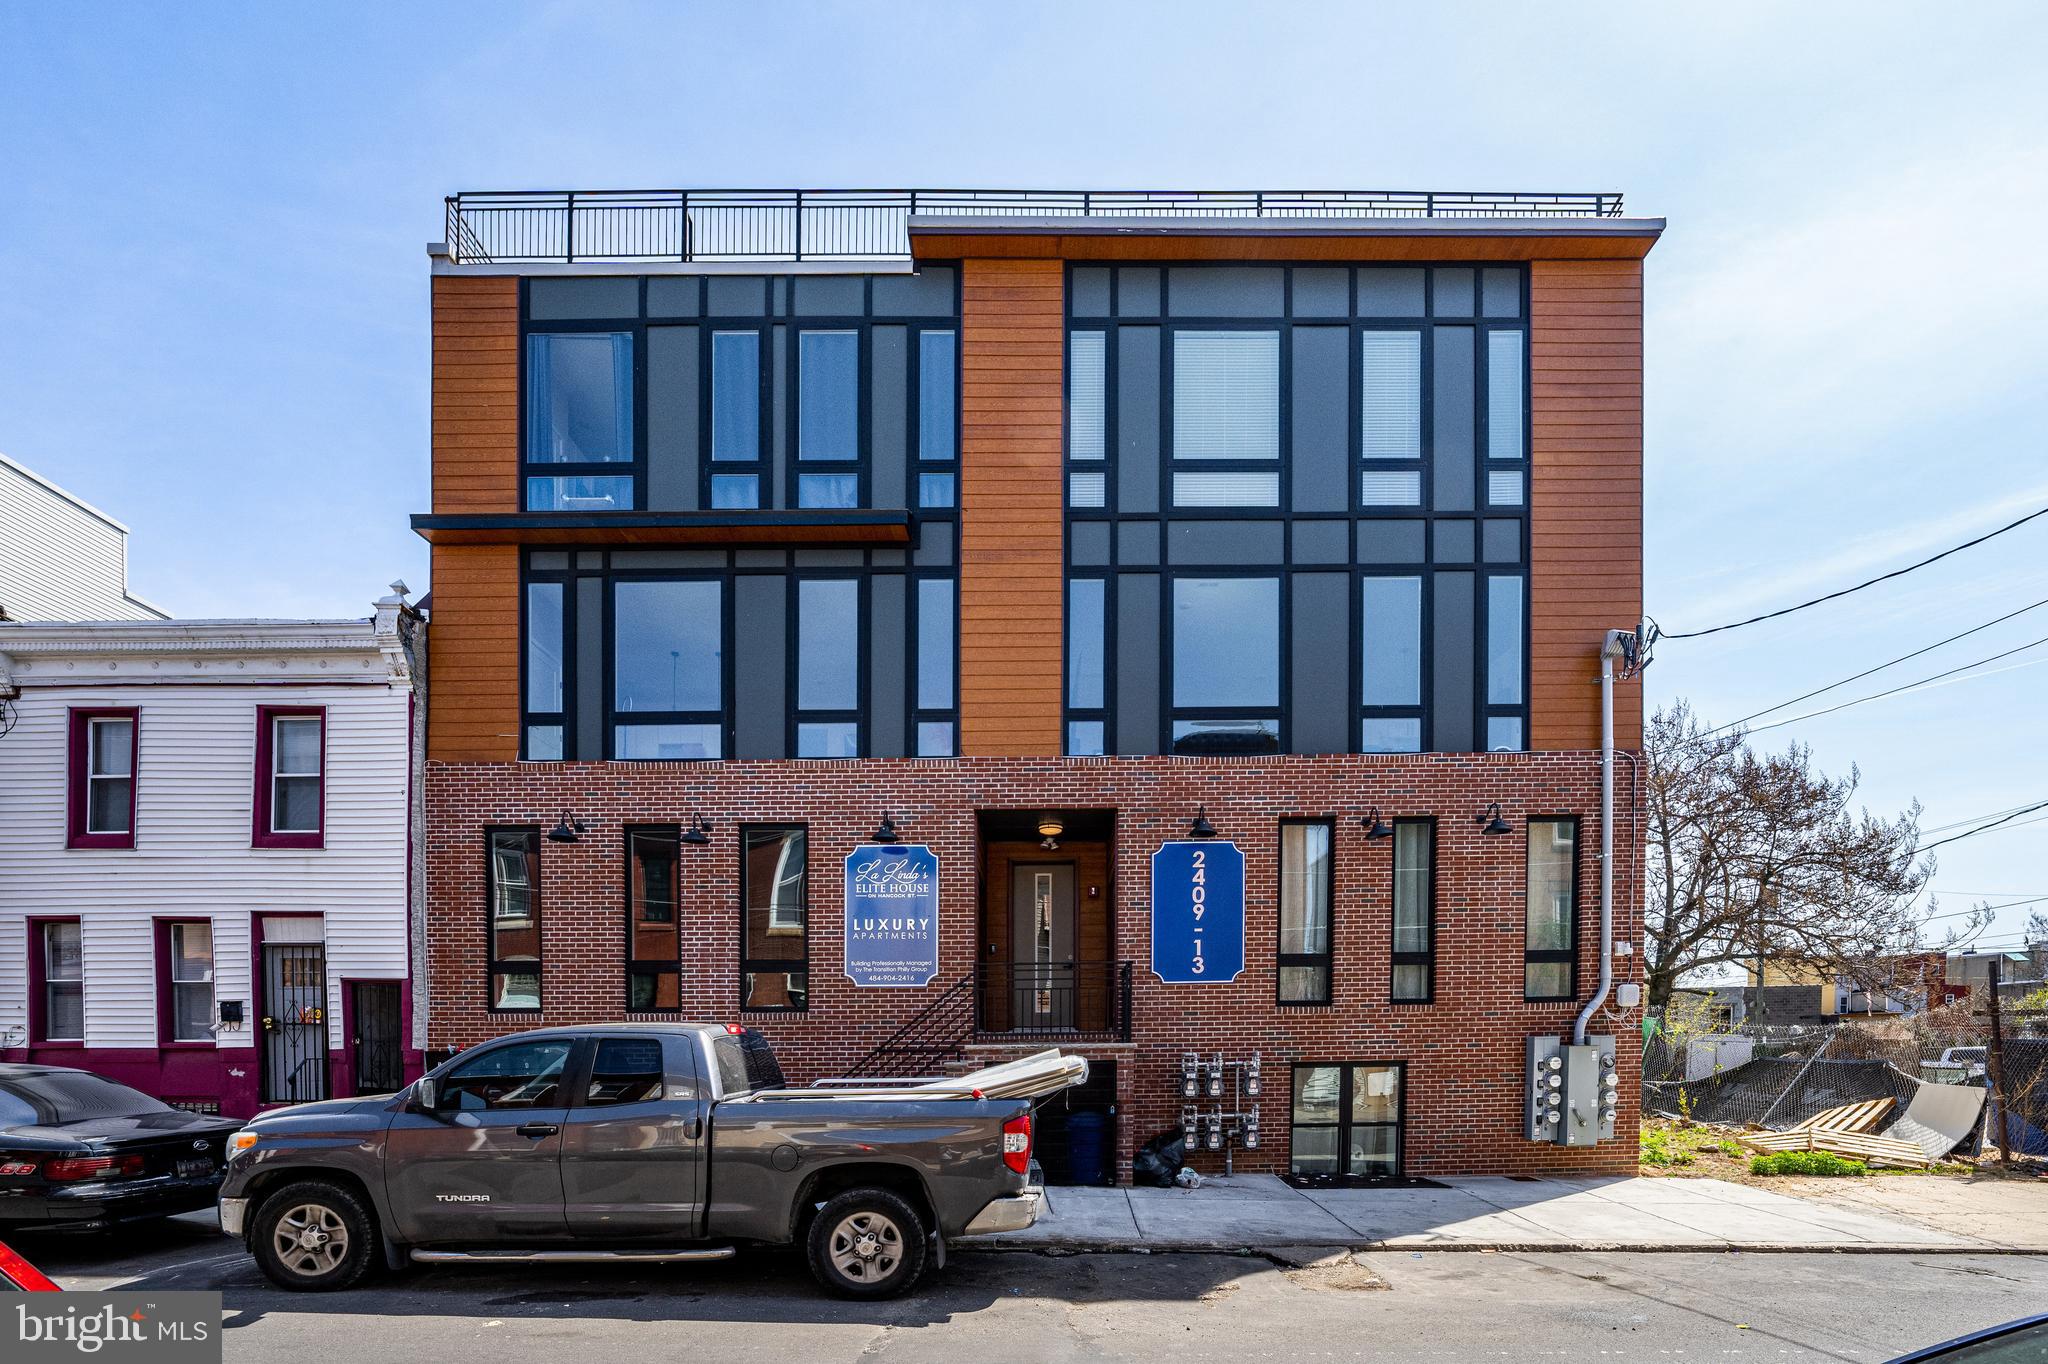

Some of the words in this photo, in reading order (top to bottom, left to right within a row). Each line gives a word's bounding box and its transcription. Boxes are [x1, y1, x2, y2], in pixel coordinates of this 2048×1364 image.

[855, 859, 882, 883] La
[882, 859, 929, 884] Linda's
[856, 883, 886, 893] ELITE
[890, 883, 929, 893] HOUSE
[1191, 850, 1206, 974] 2409-13
[853, 918, 929, 931] LUXURY
[852, 931, 928, 940] APARTMENTS
